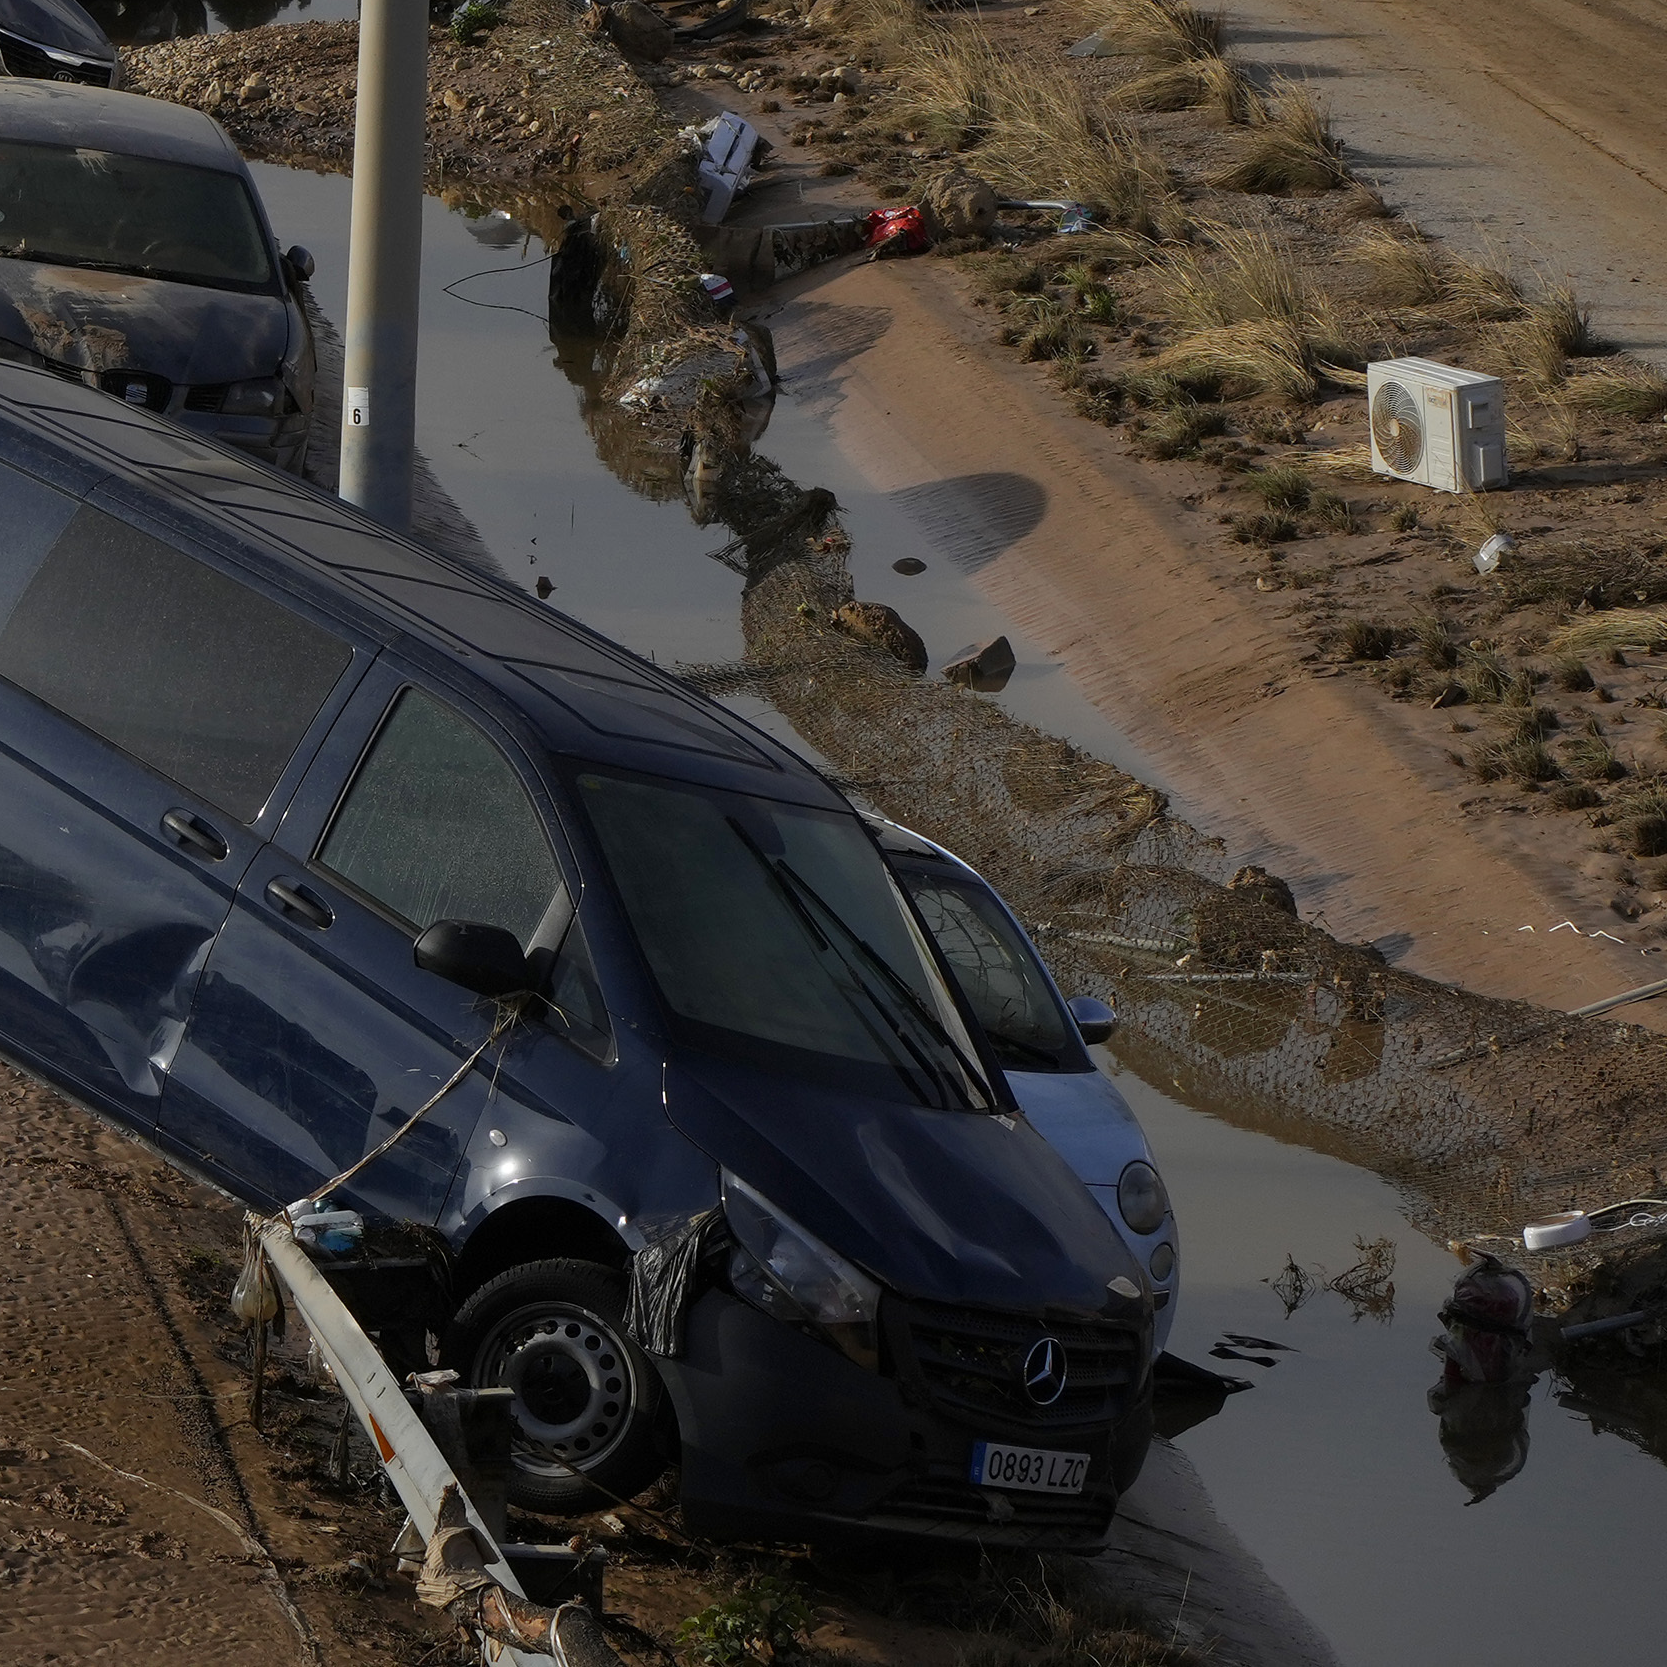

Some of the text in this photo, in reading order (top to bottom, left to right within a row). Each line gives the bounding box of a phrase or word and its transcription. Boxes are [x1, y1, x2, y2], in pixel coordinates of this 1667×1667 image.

[353, 408, 361, 424] 6
[988, 1451, 1084, 1487] 0893 LZC
